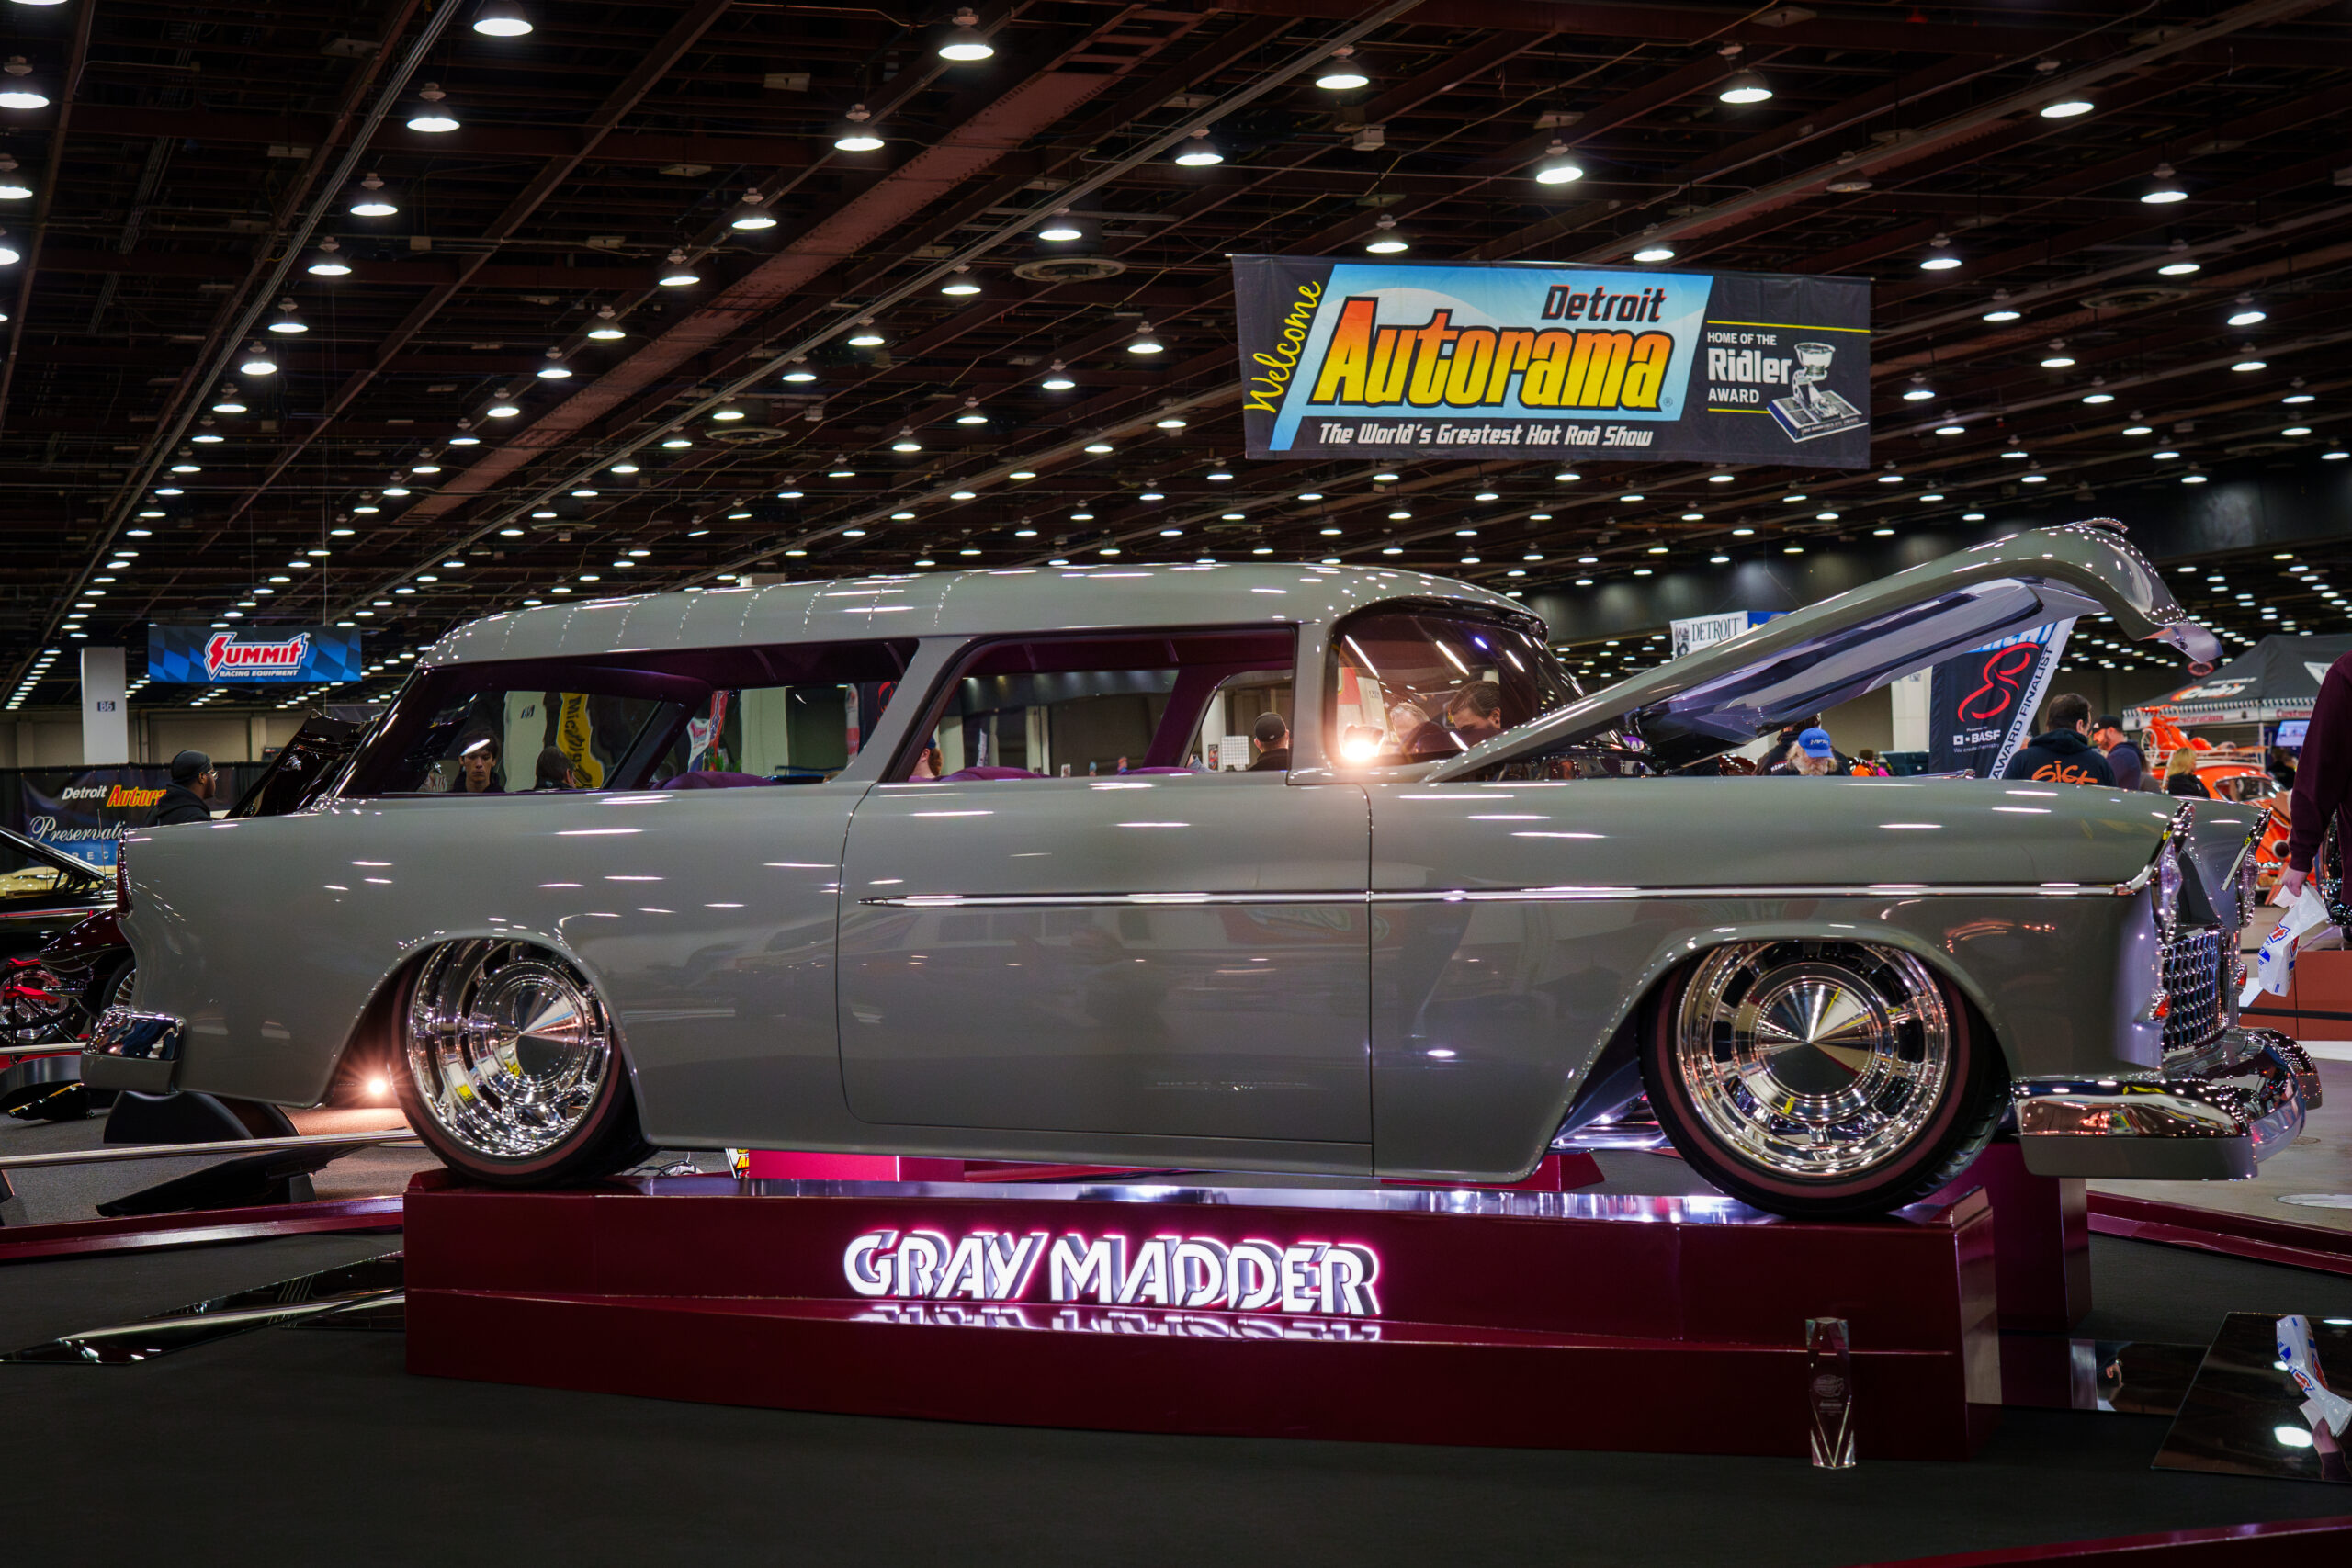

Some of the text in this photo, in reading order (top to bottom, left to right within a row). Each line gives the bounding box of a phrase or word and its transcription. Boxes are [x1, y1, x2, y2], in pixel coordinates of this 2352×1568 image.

[1541, 285, 1668, 322] Detroit
[1243, 281, 1321, 412] Welcome
[1306, 296, 1675, 412] Autorama
[1707, 332, 1777, 345] HOME OF THE
[1707, 347, 1792, 384] Ridler
[1707, 388, 1759, 403] AWARD
[1319, 423, 1654, 446] The World's Greatest Hot Rod Show
[1692, 618, 1738, 642] DETROIT
[207, 634, 305, 675] SUMMIT
[1992, 646, 2053, 780] AWARD FINALIST
[1971, 730, 2001, 744] BASF
[62, 785, 107, 800] Detroit
[843, 1230, 1381, 1315] GRAY MADDER
